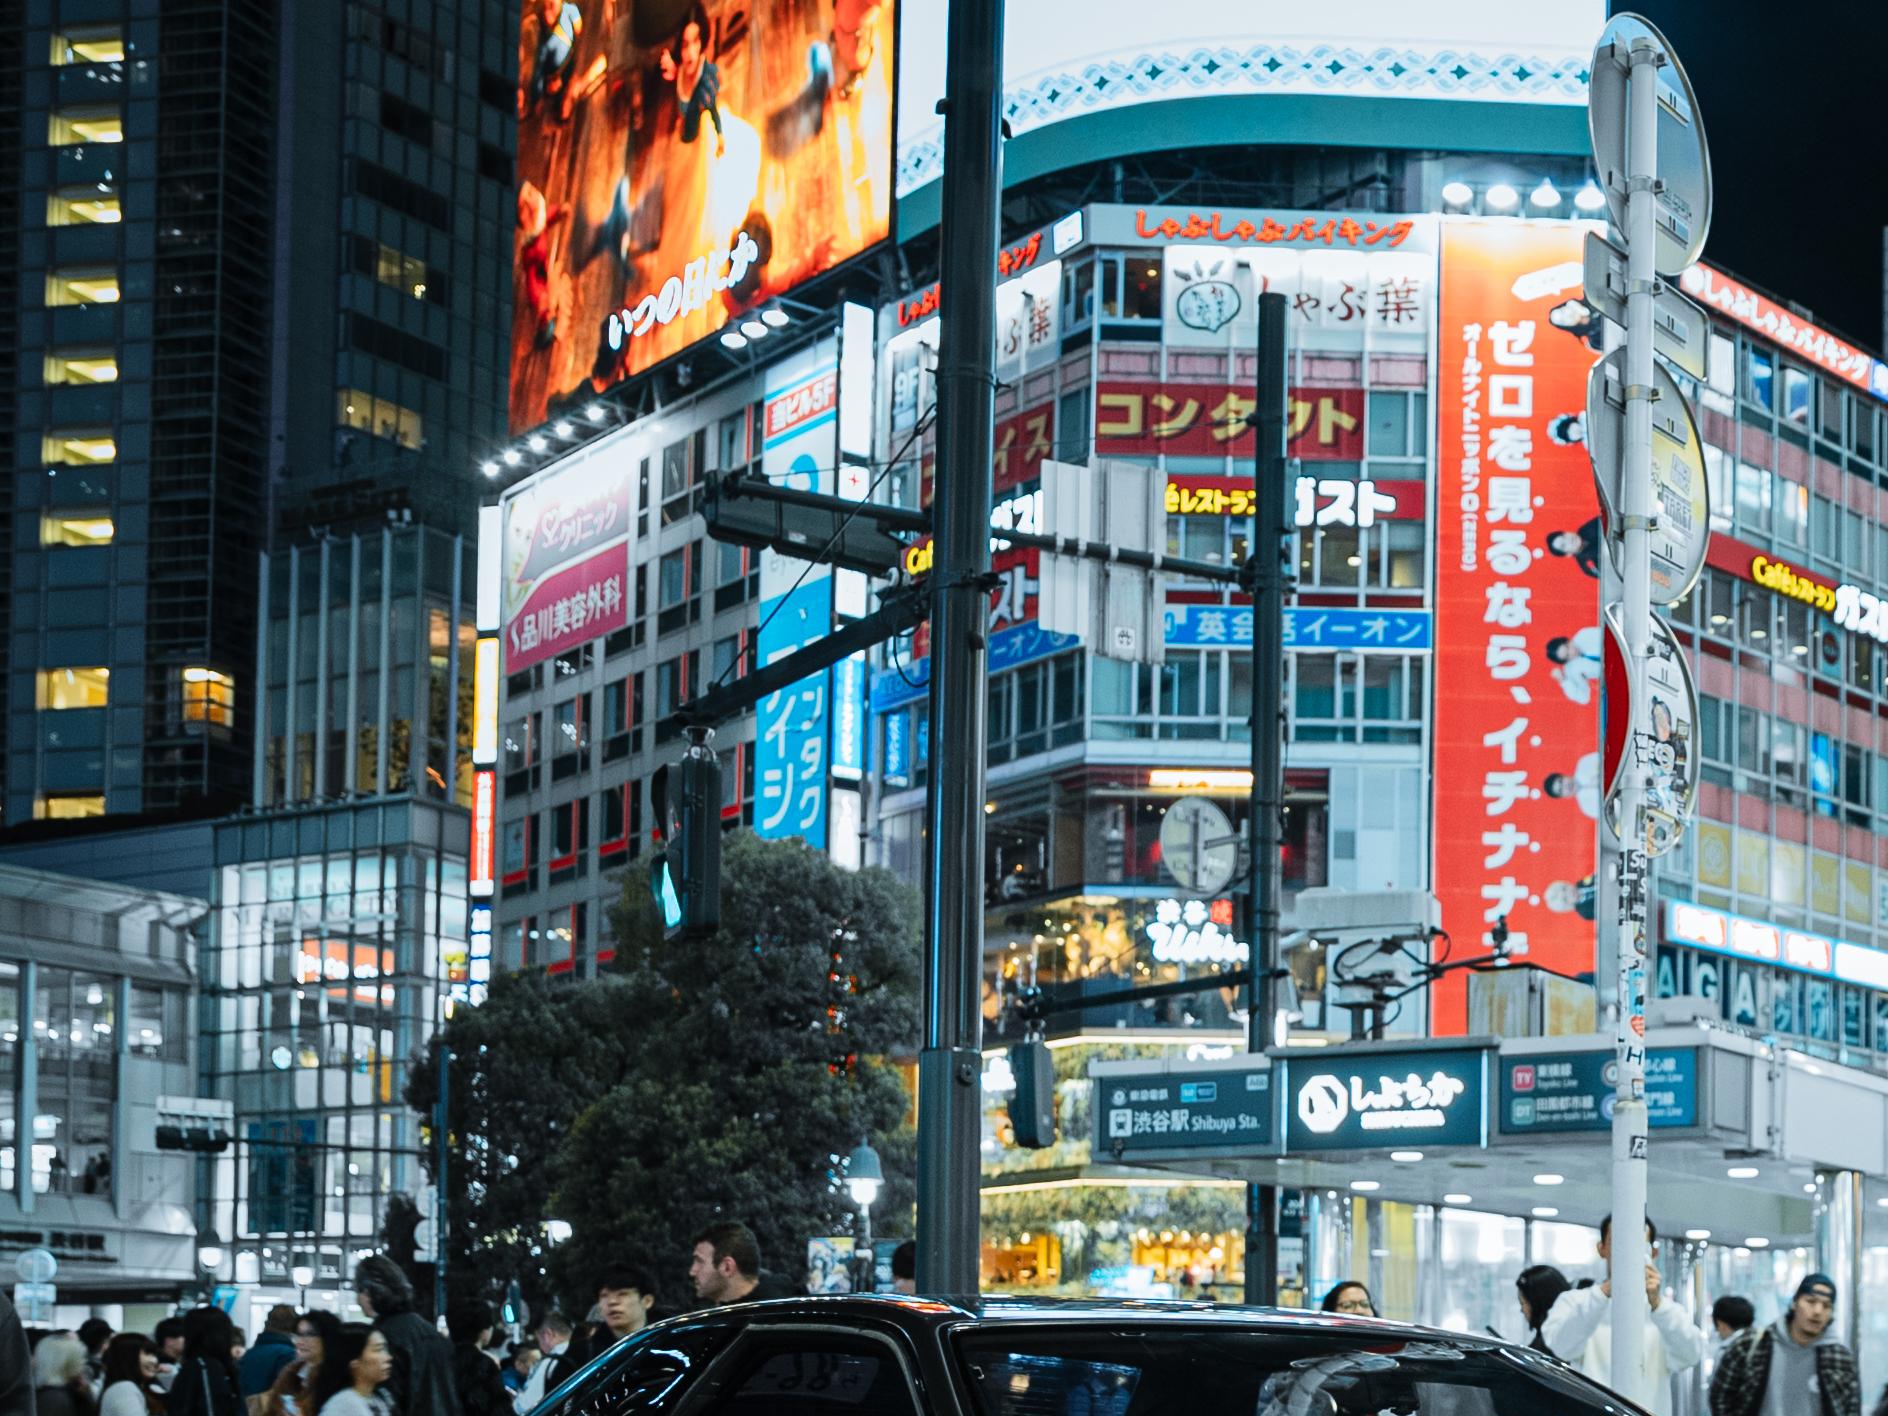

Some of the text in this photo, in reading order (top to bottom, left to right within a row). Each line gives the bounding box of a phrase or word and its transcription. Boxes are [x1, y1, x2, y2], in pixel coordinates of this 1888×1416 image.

[1135, 208, 1414, 246] しゃぶしゃぶバイキング
[608, 230, 758, 351] いつの日にか
[521, 573, 622, 652] 品川美容外科
[1133, 1109, 1261, 1134] 渋谷駅 Shibuya Sta.
